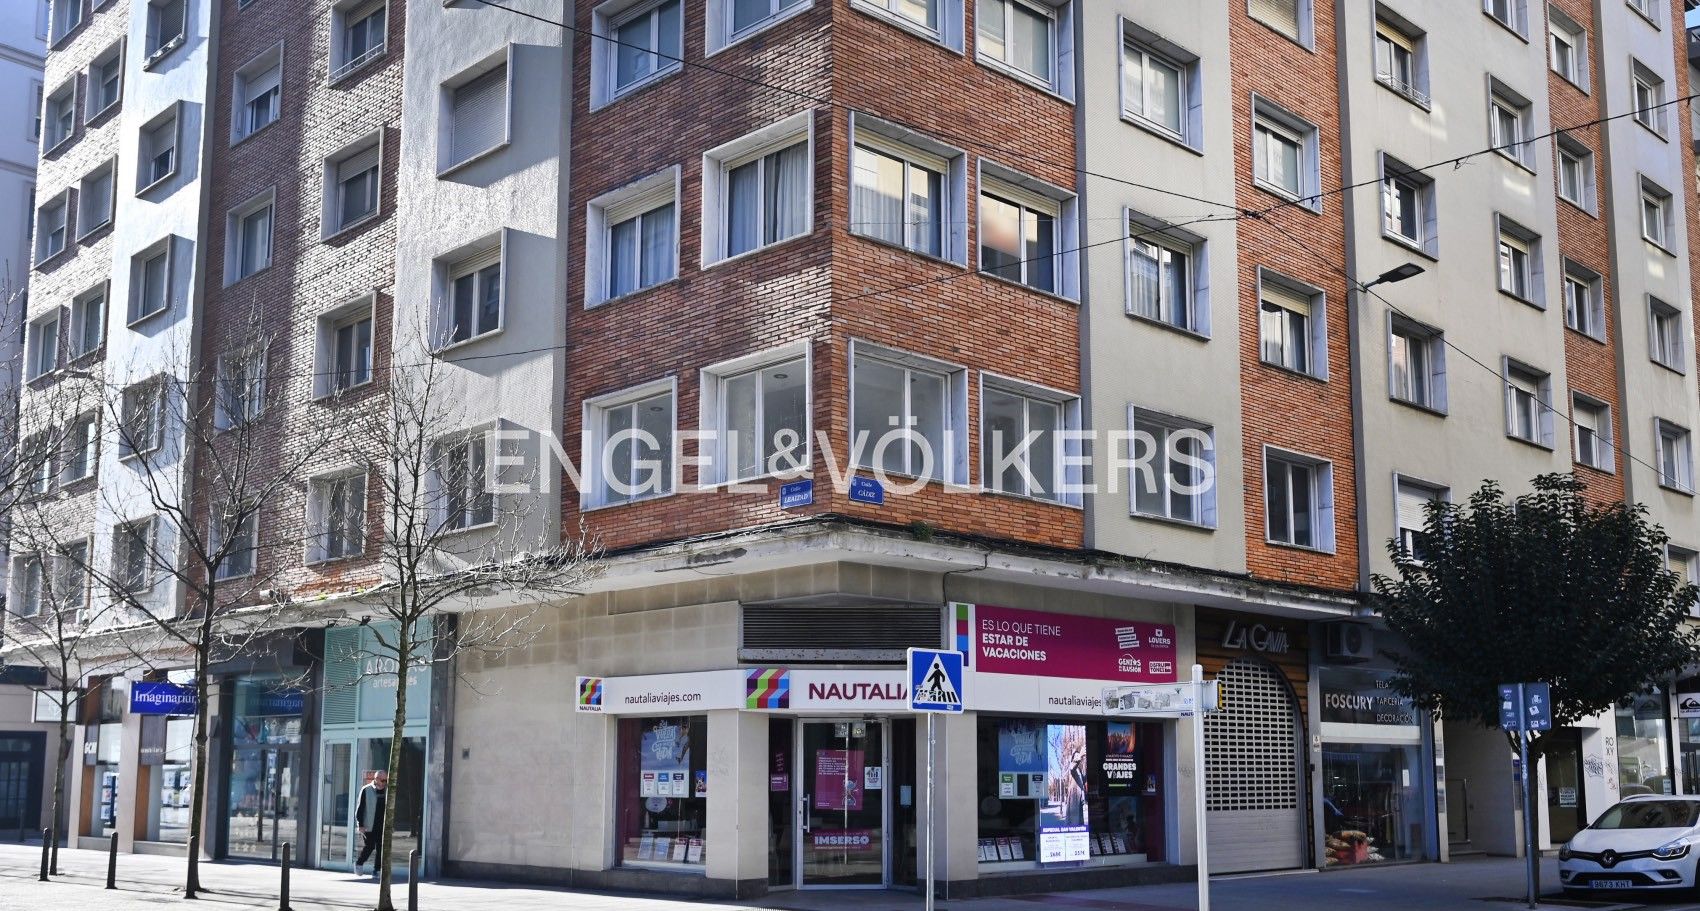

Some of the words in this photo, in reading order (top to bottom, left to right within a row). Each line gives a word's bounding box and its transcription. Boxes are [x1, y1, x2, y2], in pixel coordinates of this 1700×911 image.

[784, 493, 808, 503] LEALTAD
[982, 619, 994, 630] ES
[996, 620, 1010, 632] LO
[1011, 621, 1033, 634] QUE
[1034, 623, 1061, 636] TIENE
[982, 633, 1013, 645] ESTAR
[1015, 636, 1029, 646] DE
[1148, 637, 1171, 645] LOVERS
[982, 646, 1047, 661] VACACIONES
[624, 692, 701, 705] nautaliaviajes.com
[1325, 693, 1374, 711] FOSCURY
[1102, 762, 1137, 771] GRANDES
[815, 836, 869, 845] IMSERSO
